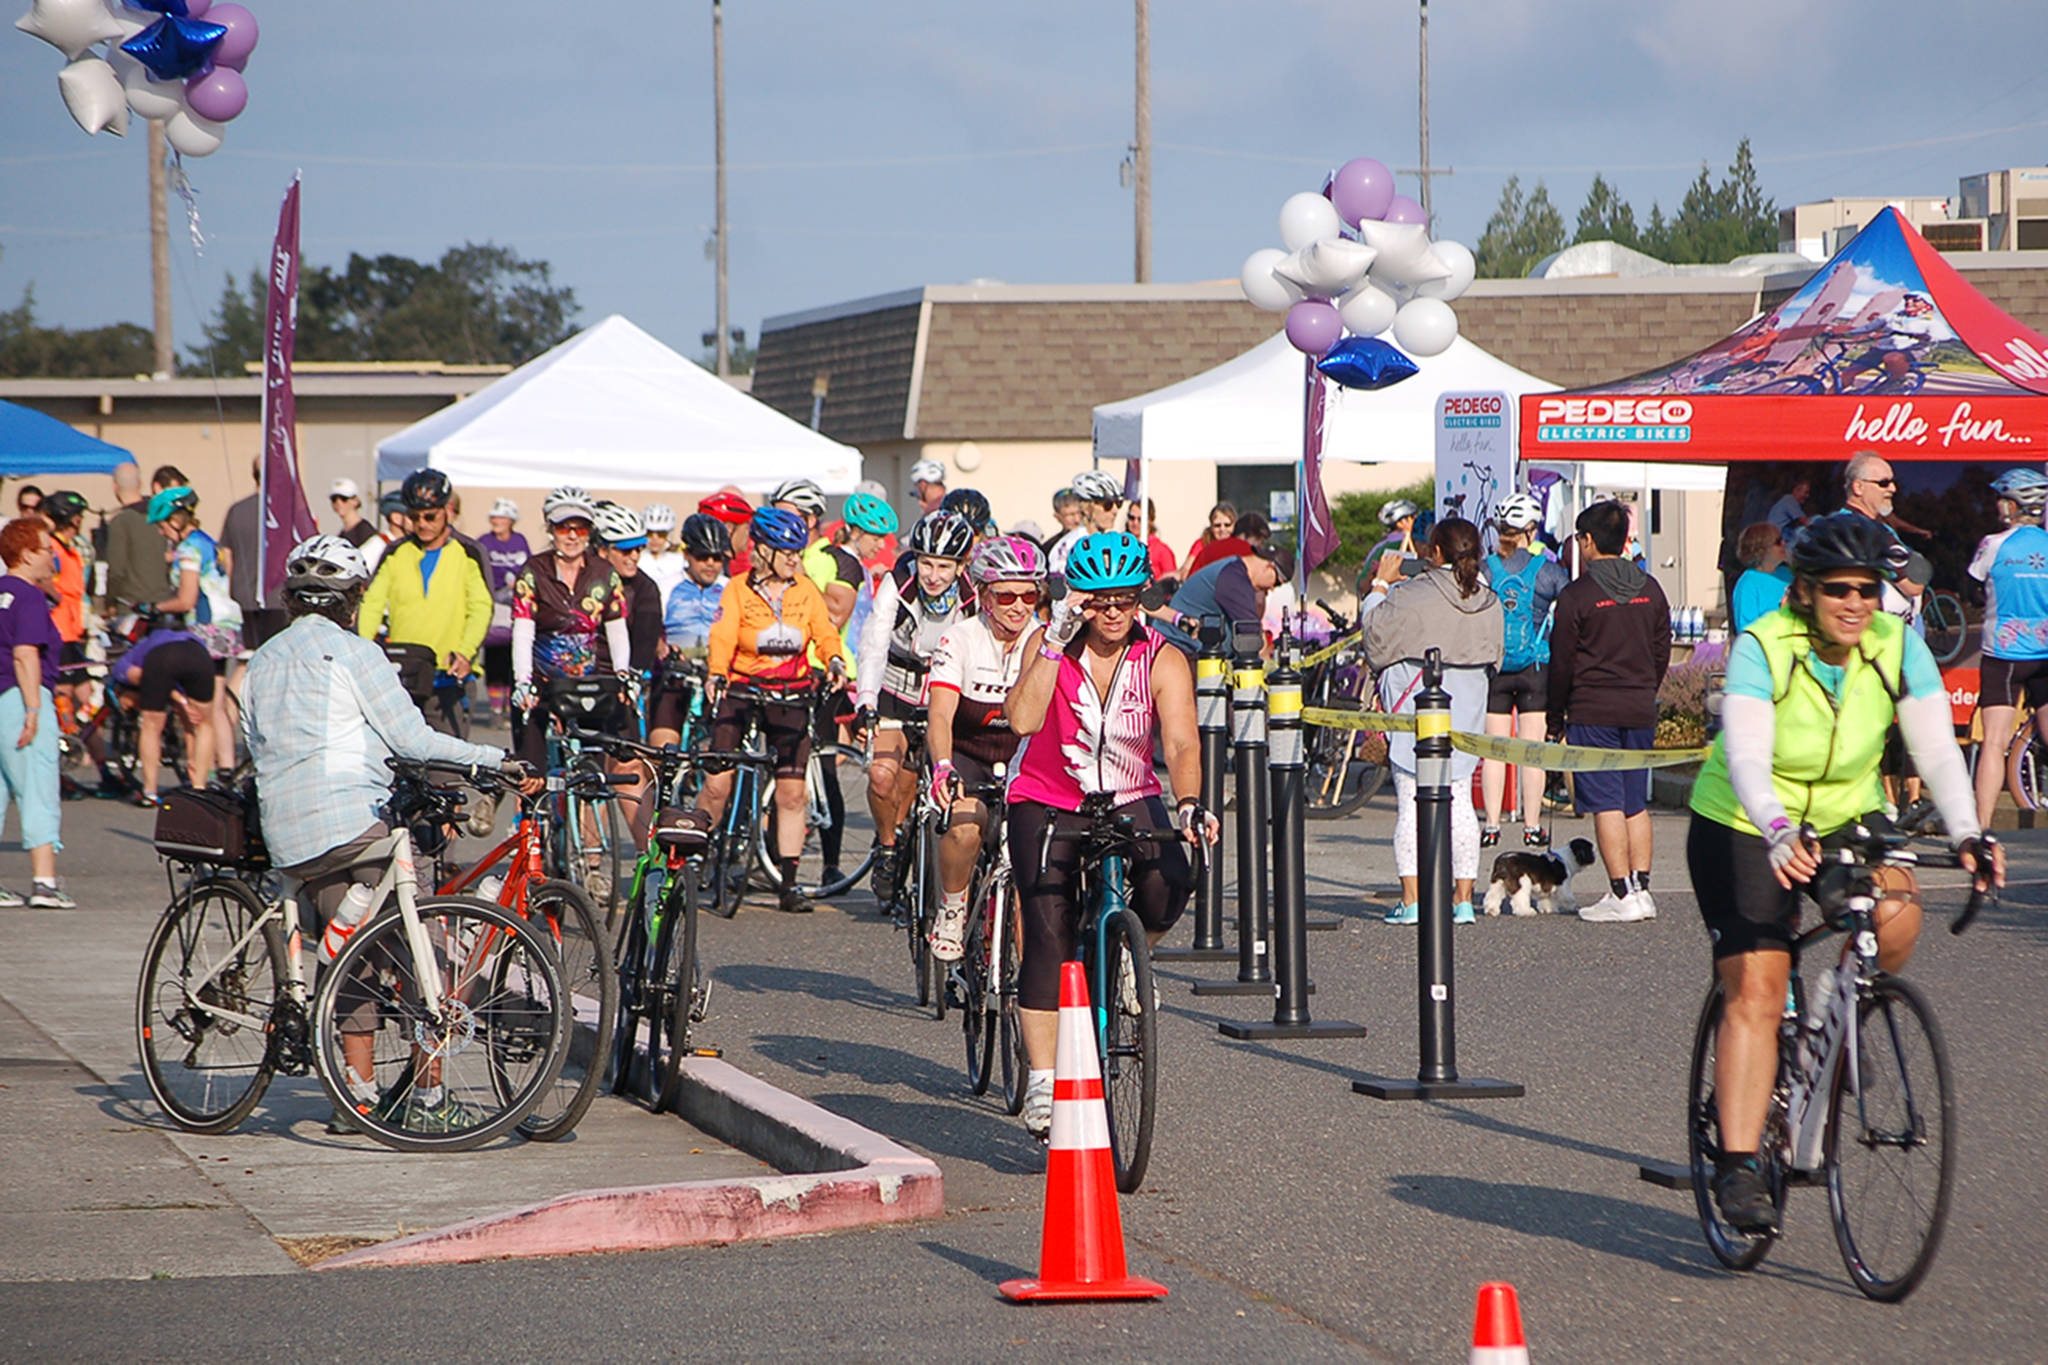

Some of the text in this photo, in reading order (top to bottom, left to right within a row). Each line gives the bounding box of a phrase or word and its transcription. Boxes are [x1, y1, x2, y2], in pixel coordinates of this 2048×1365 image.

[1444, 397, 1502, 414] PEDEGO
[1538, 399, 1693, 424] PEDEGO
[1541, 427, 1687, 440] ELECTRIC BIKES
[1844, 402, 2032, 447] hello, fun...
